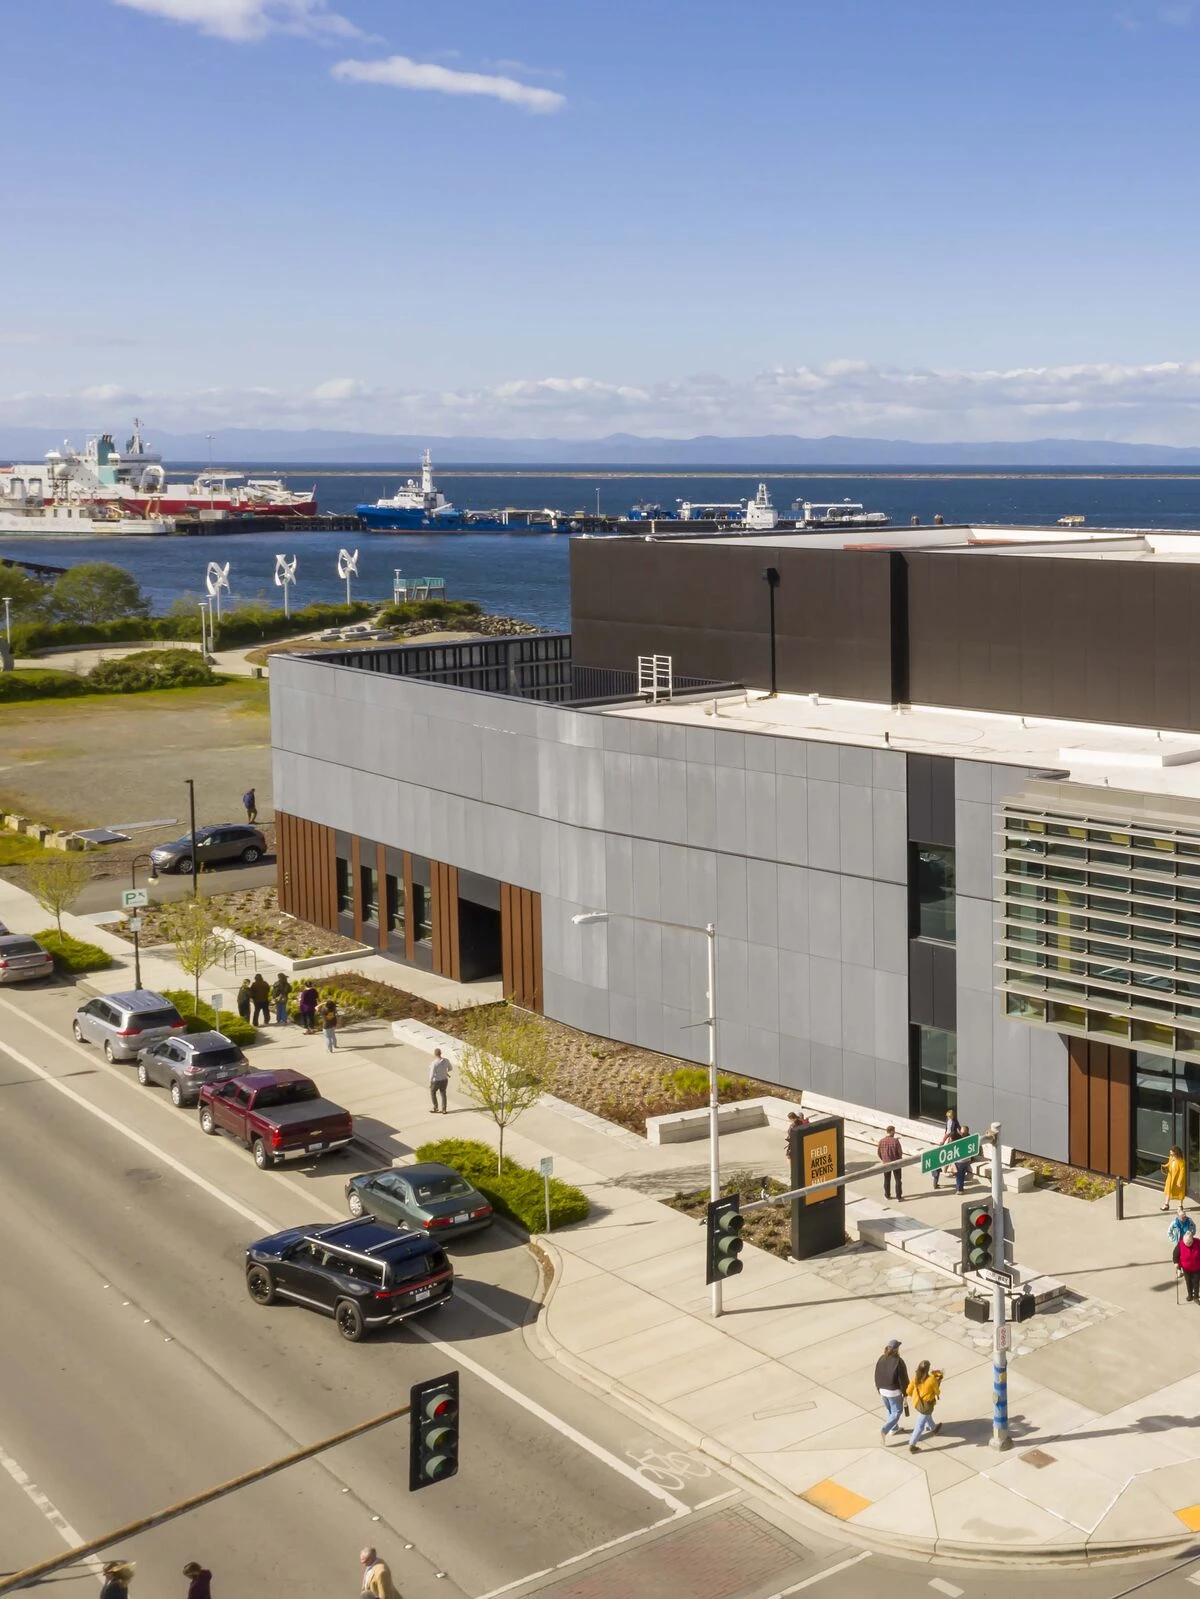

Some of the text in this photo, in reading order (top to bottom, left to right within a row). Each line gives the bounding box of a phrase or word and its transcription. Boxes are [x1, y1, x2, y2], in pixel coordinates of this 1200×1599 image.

[125, 892, 137, 905] P
[810, 1145, 828, 1158] FIELD
[925, 1142, 976, 1169] N Oak St
[811, 1154, 833, 1169] ARTS &
[811, 1164, 834, 1179] EVENTS
